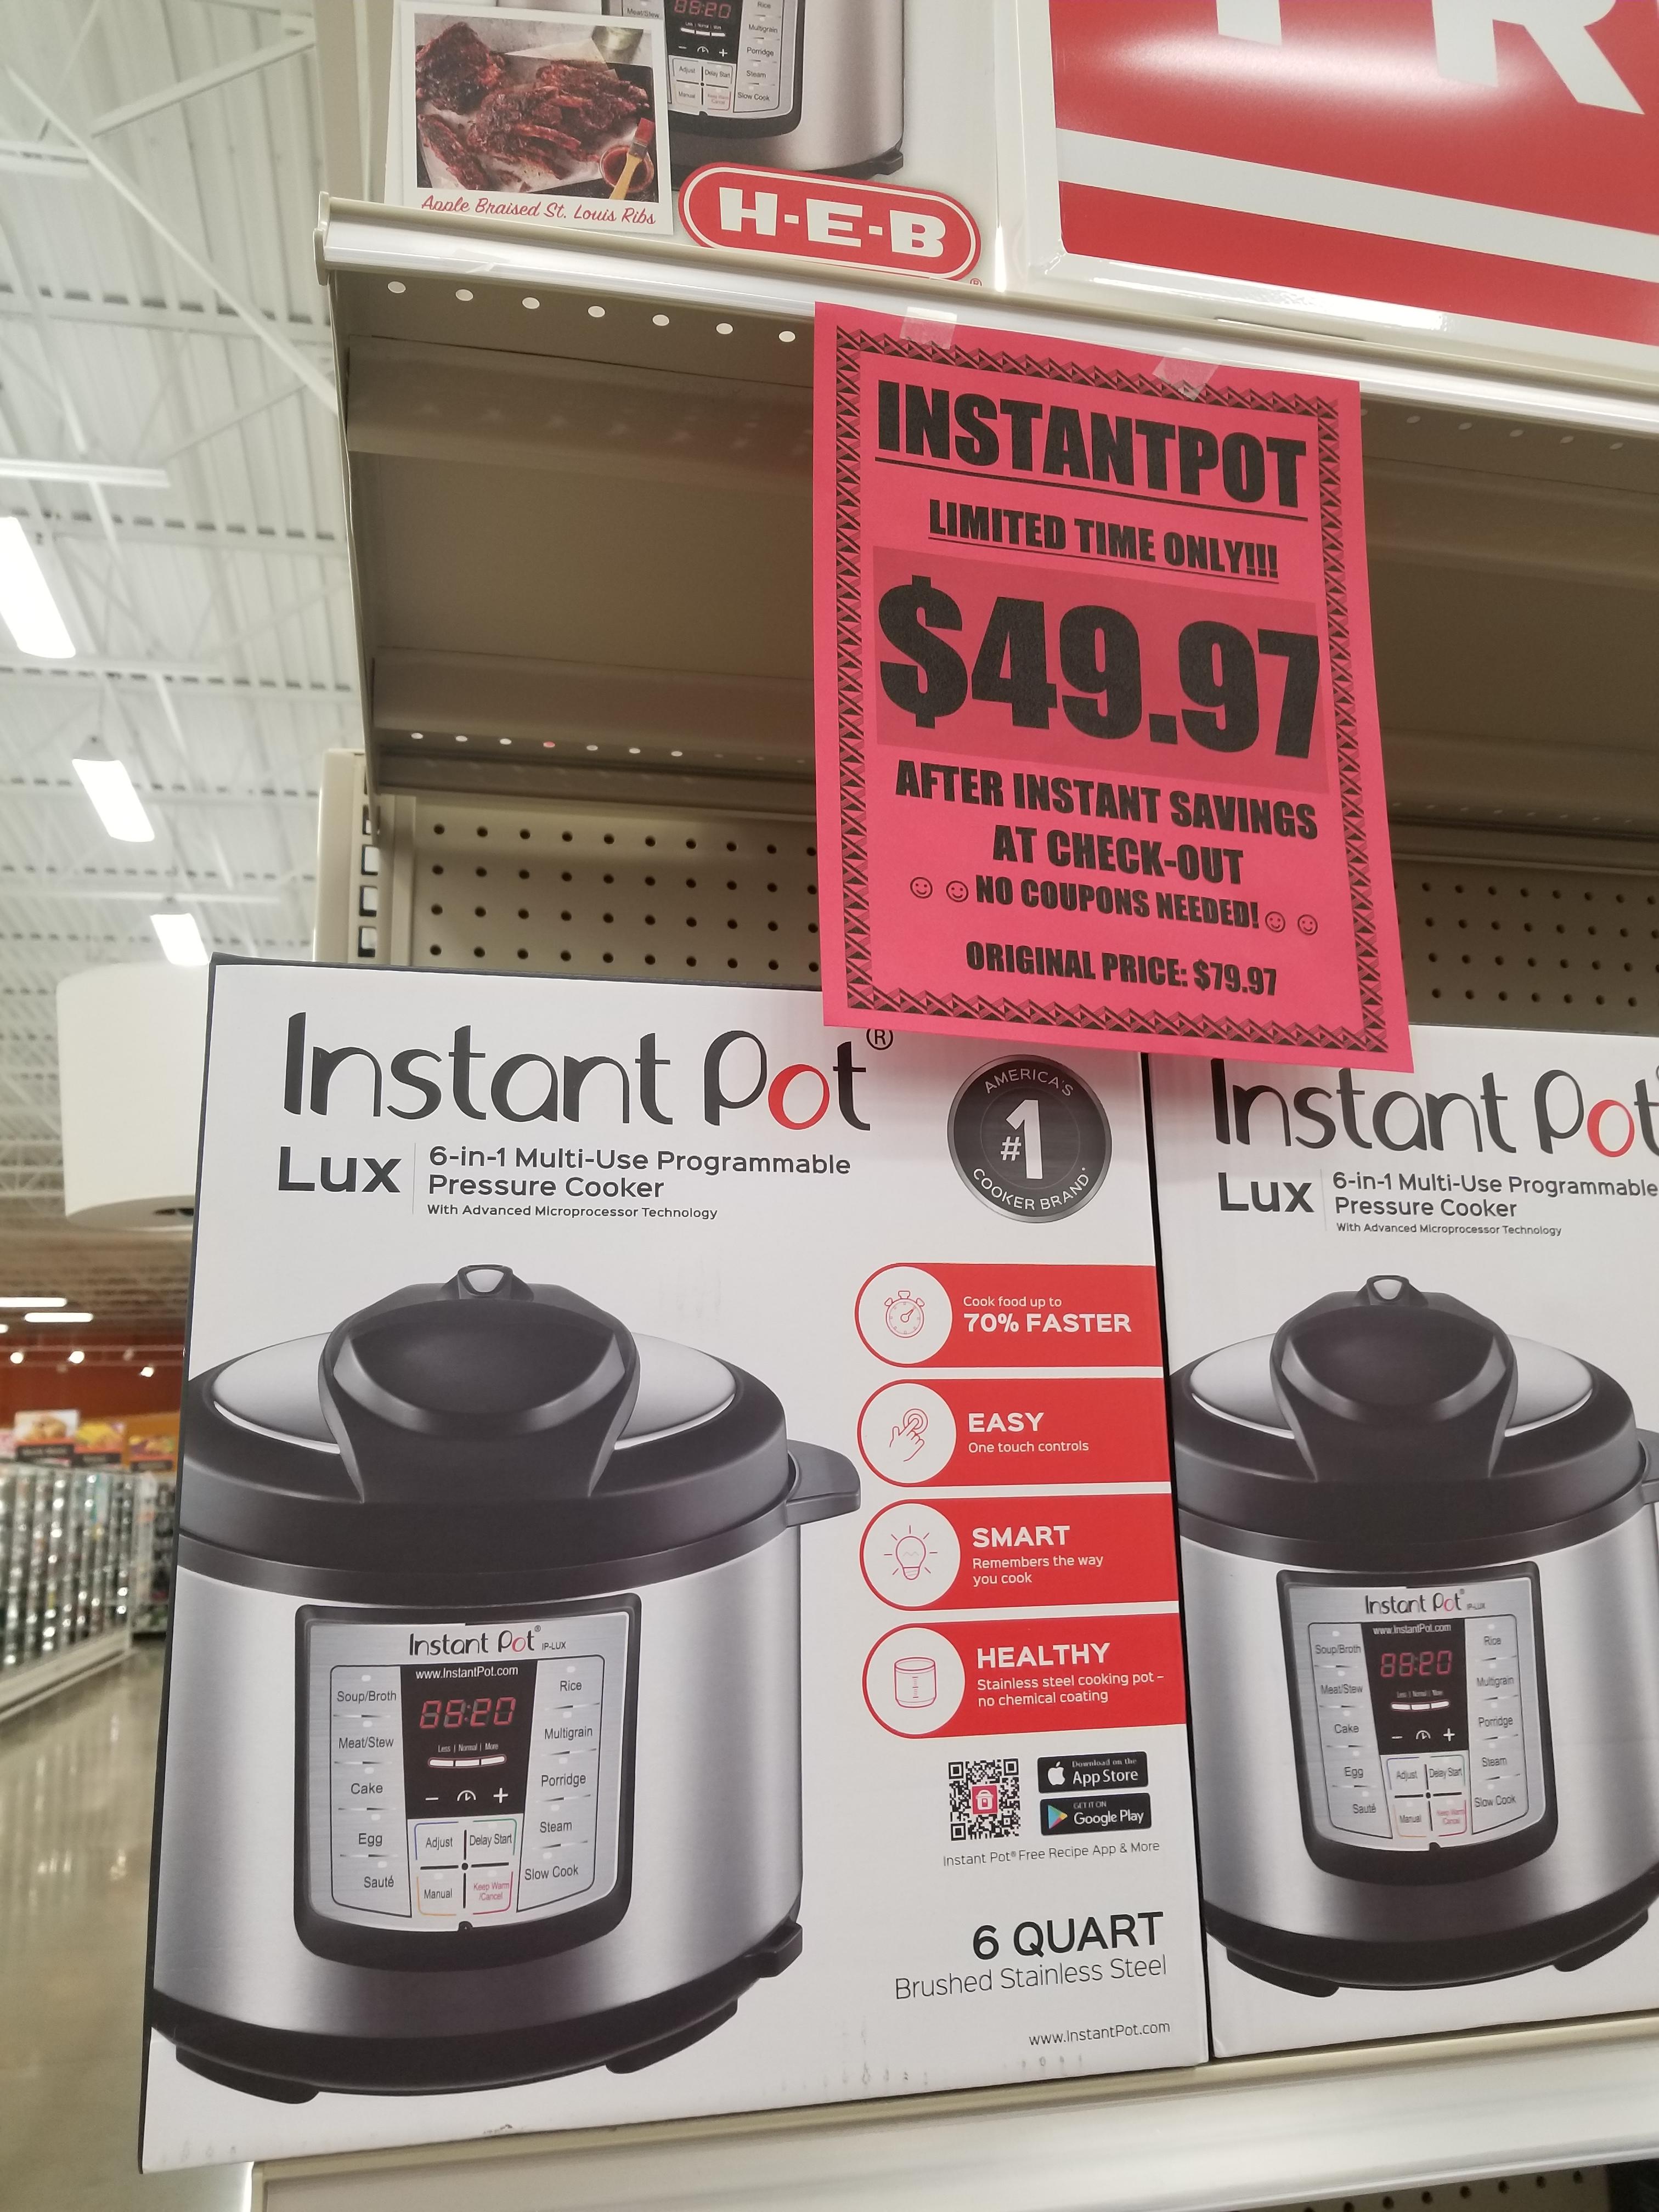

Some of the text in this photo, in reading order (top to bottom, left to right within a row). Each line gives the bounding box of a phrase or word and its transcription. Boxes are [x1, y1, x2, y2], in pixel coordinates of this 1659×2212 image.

[627, 8, 659, 18] Meat/Stew
[748, 24, 778, 33] Multigrain
[747, 47, 774, 57] Porridge
[679, 66, 695, 74] Adjust
[705, 70, 718, 78] Delay
[747, 70, 766, 78] Steam
[754, 93, 770, 101] Cook
[475, 197, 540, 217] Braised
[543, 202, 566, 218] St.
[574, 205, 616, 222] Louis
[621, 207, 656, 224] Ribs
[878, 380, 1307, 509] INSTANTPOT
[930, 499, 1278, 578] LIMITED TIME ONLY!!!
[878, 574, 1319, 759] $49.97
[896, 759, 1318, 840] AFTER INSTANT SAVINGS
[992, 825, 1244, 884] AT CHECK-OUT
[975, 874, 1260, 930] NO COUPONS NEEDED!
[966, 941, 1277, 996] ORIGINAL PRICE: $79.97
[284, 1012, 673, 1126] Instant
[985, 1068, 1074, 1096] AMERICA'S
[1210, 1058, 1516, 1153] Instant
[278, 1146, 402, 1194] Lux
[429, 1146, 851, 1179] 6-in-1 Multi-Use Programmable
[429, 1174, 664, 1199] Pressure Cooker
[973, 1168, 1036, 1211] COOKER
[1217, 1172, 1314, 1212] Lux
[1333, 1171, 1658, 1198] 6-in-1 Multi-Use Programmable
[427, 1204, 718, 1221] With Advanced Microprocessor Technology
[1335, 1197, 1517, 1217] Pressure Cooker
[1336, 1222, 1561, 1237] With Advanced Microprocessor Technology
[963, 1296, 1062, 1310] Cook food up to
[963, 1313, 1132, 1333] 70% FASTER
[968, 1412, 1045, 1433] EASY
[968, 1441, 1089, 1453] One touch controls
[972, 1525, 1070, 1548] SMART
[973, 1555, 1104, 1570] Remembers the way
[973, 1572, 1032, 1587] you cook
[1365, 1595, 1426, 1615] Instant
[1373, 1624, 1452, 1635] www.InstantPot.com
[409, 1632, 488, 1656] Instant
[541, 1641, 566, 1651] IP-LUX
[1484, 1636, 1502, 1646] Rice
[977, 1642, 1110, 1669] HEALTHY
[1315, 1644, 1361, 1656] Soup/Broth
[416, 1666, 518, 1680] www.InstantPot.com
[560, 1680, 582, 1692] Rice
[977, 1672, 1154, 1691] Stainless steel cooking pot
[1321, 1684, 1363, 1694] Meat/Stew
[1477, 1675, 1515, 1688] Multigrain
[337, 1690, 397, 1703] Soup/Broth
[978, 1690, 1109, 1707] no chemical coating
[1334, 1724, 1359, 1734] Cake
[1478, 1716, 1513, 1728] Porridge
[544, 1726, 593, 1741] Multigrain
[338, 1736, 394, 1750] Meat/Stew
[438, 1742, 499, 1752] Less Normal More
[1072, 1759, 1110, 1768] Download
[1482, 1756, 1507, 1767] Steam
[541, 1773, 586, 1788] Porridge
[1073, 1768, 1139, 1786] App Store
[1344, 1767, 1364, 1779] Egg
[1396, 1770, 1418, 1780] Adjust
[1429, 1768, 1463, 1779] Delay Start
[351, 1782, 383, 1795] Cake
[1475, 1795, 1516, 1808] Slow Cook
[1074, 1809, 1144, 1827] Google Play
[1400, 1814, 1421, 1824] Manual
[539, 1820, 572, 1833] Steam
[358, 1833, 383, 1847] Egg
[425, 1837, 453, 1849] Adjust
[470, 1833, 512, 1847] Delay Start
[944, 1854, 986, 1866] Instant
[1019, 1849, 1046, 1860] Free
[1049, 1846, 1089, 1860] Recipe
[1092, 1844, 1117, 1858] App
[1120, 1844, 1128, 1854] &
[1131, 1841, 1160, 1853] More
[524, 1864, 579, 1881] Slow Cook
[364, 1875, 394, 1888] Sauté
[473, 1882, 490, 1892] Keep
[424, 1888, 453, 1899] Manual
[973, 1911, 1163, 1960] 6 QUART
[895, 1954, 1166, 2000] Brushed Stainless Steel
[1029, 2022, 1170, 2046] www.InstantPot.com
